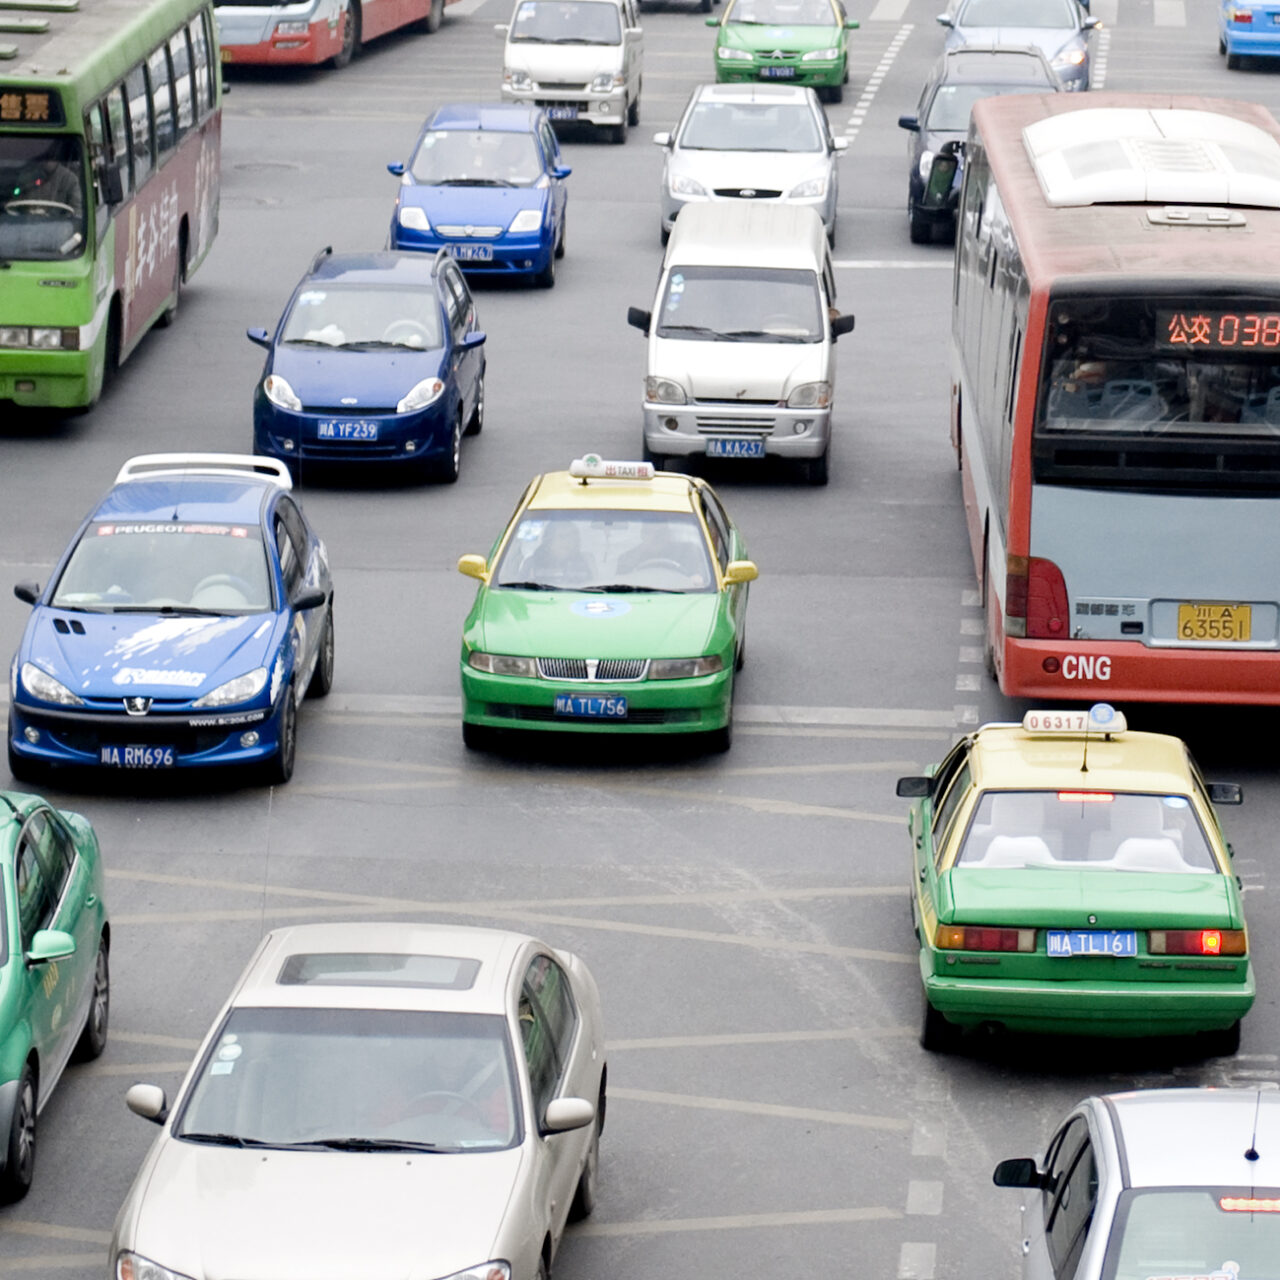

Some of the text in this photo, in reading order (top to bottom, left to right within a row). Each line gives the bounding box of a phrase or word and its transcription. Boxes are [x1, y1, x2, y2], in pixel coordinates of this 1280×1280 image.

[1168, 314, 1212, 345] 公交
[339, 423, 377, 439] YF239
[618, 466, 637, 477] TAXI
[1181, 620, 1244, 639] 63551
[1062, 655, 1112, 680] CNG
[579, 698, 626, 715] TL756
[1029, 715, 1084, 731] 06317
[125, 747, 174, 766] RM696
[1076, 934, 1132, 955] TL161
